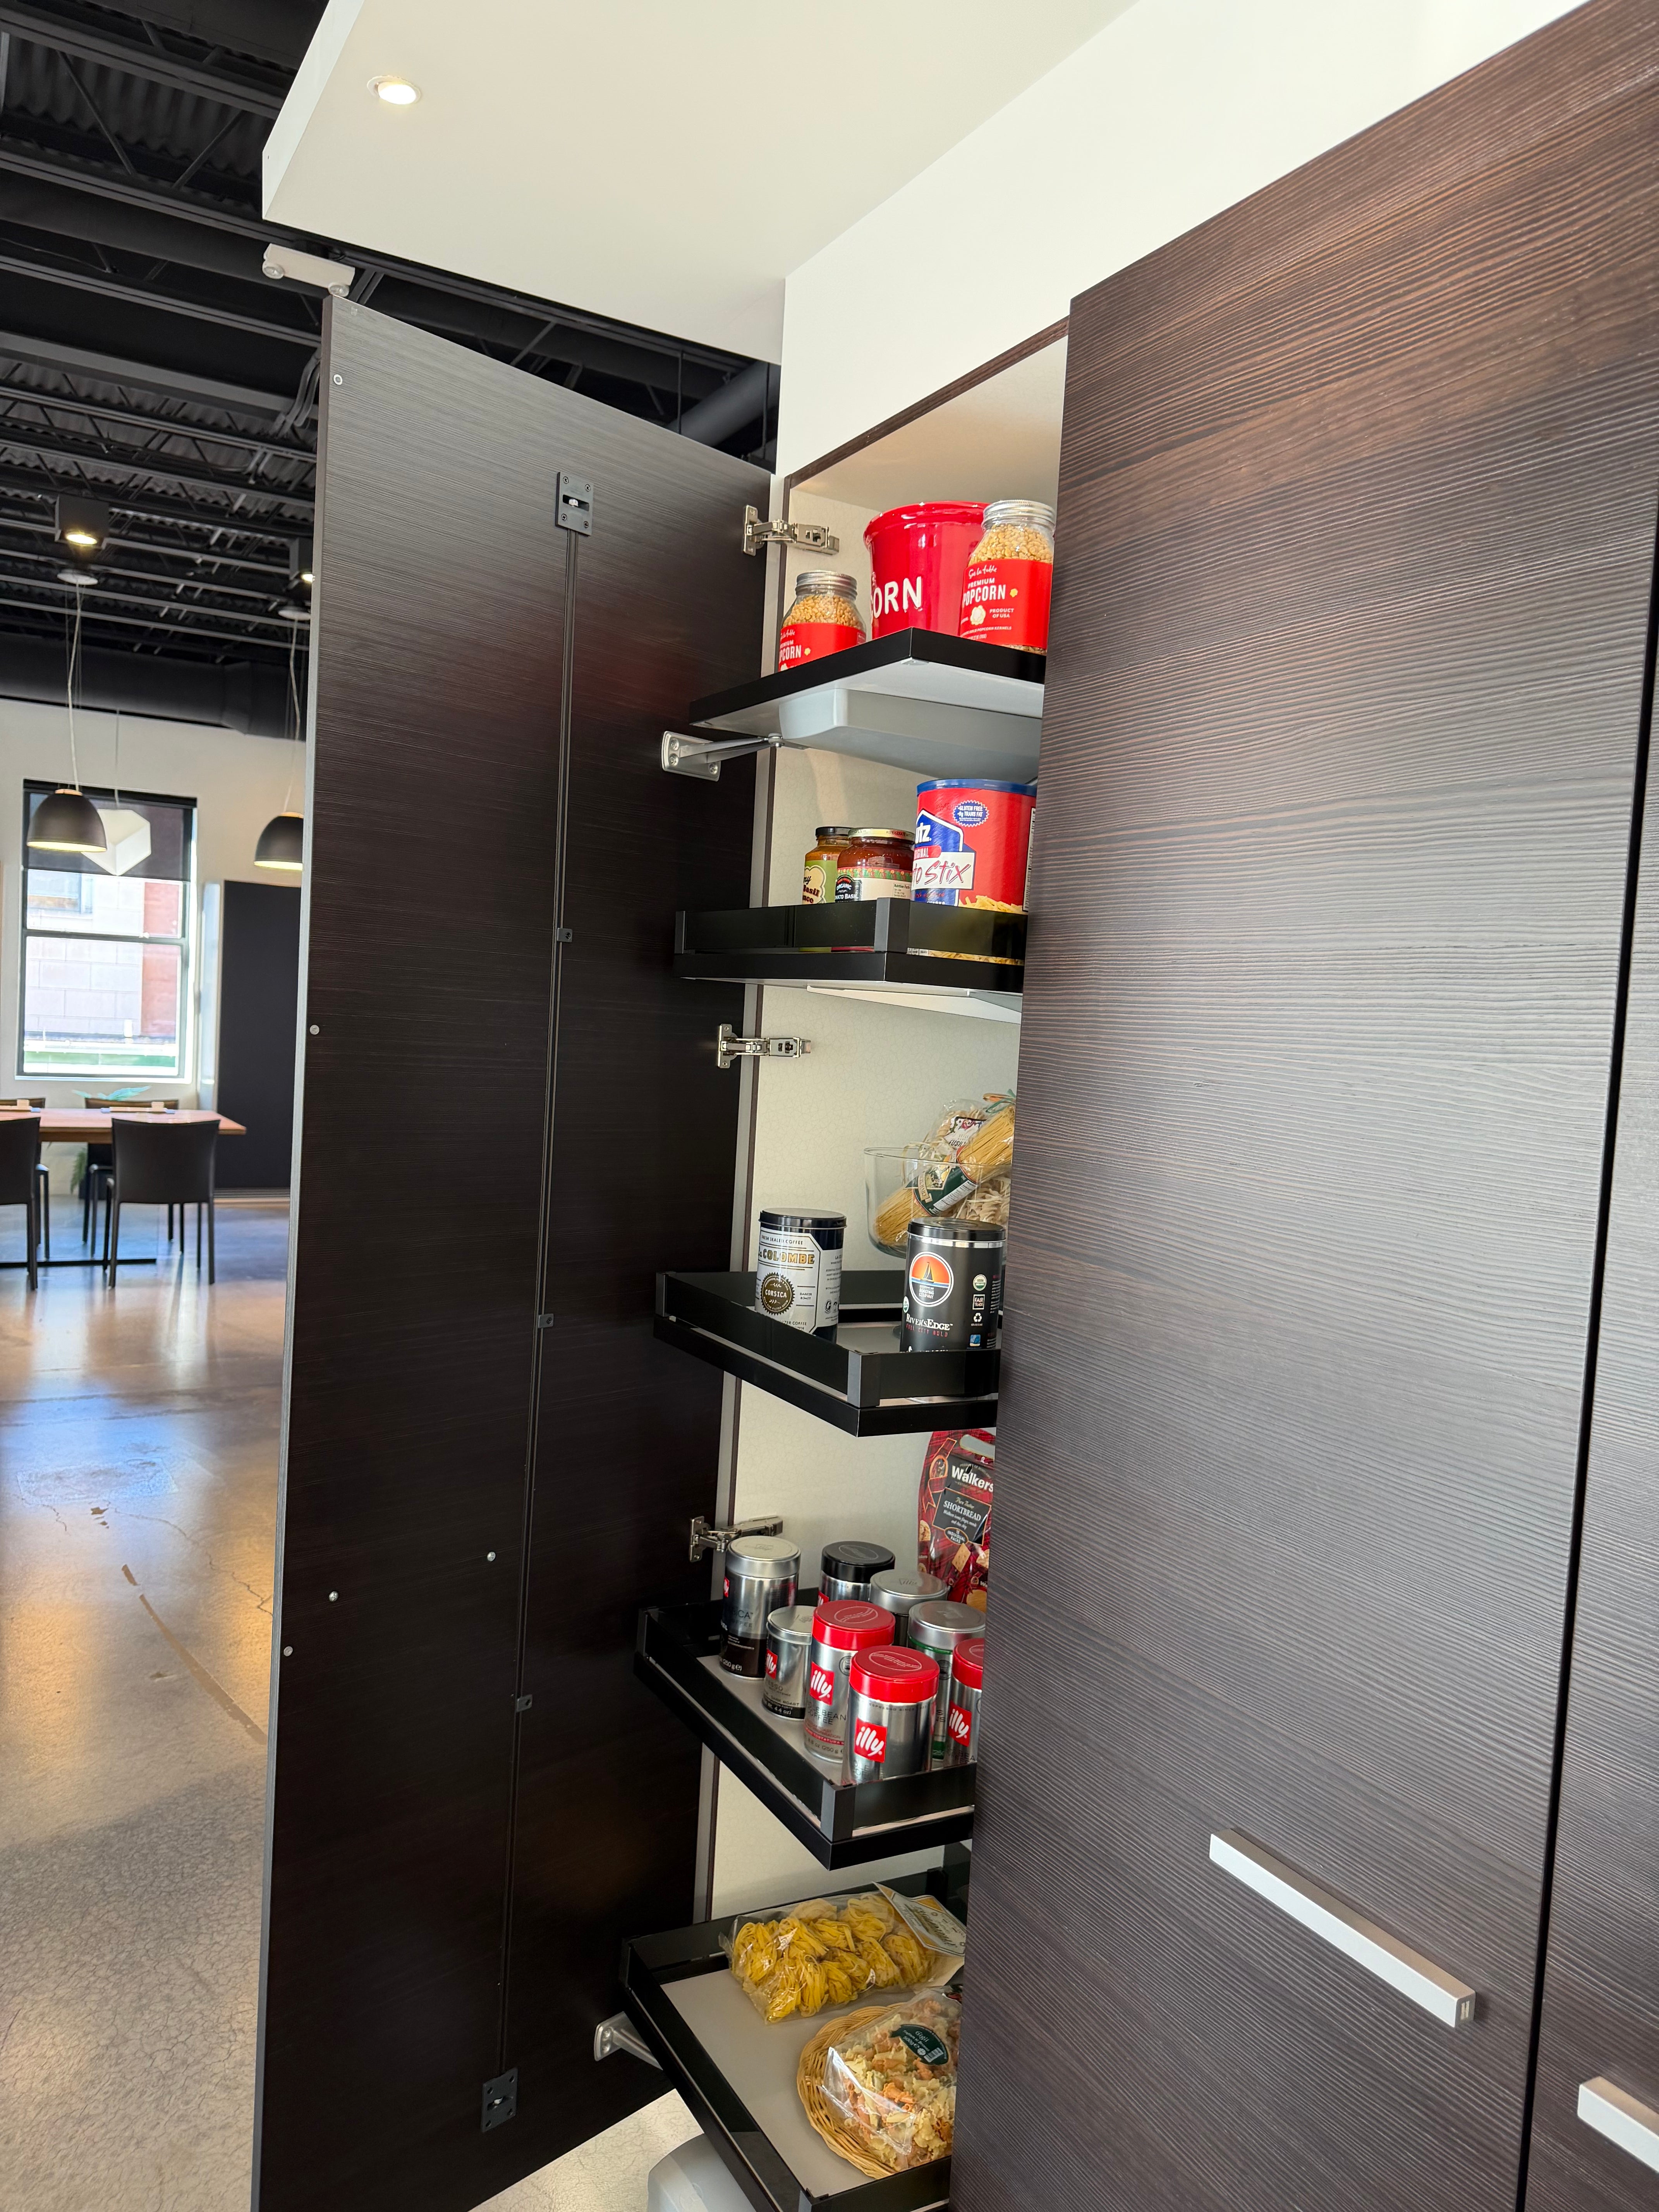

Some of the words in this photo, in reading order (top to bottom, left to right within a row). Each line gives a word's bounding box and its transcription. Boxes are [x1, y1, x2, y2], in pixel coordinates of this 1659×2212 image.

[982, 565, 997, 574] table
[968, 577, 995, 589] PREMIUM
[871, 576, 922, 621] ORN
[963, 584, 1006, 607] POPCORN
[924, 860, 971, 885] Stix
[763, 1249, 815, 1264] COLOMBE
[765, 1289, 787, 1298] CORSICA
[952, 1465, 994, 1492] Walkers
[943, 1500, 981, 1521] SHORTBREAD
[811, 1669, 832, 1698] illy
[822, 1709, 847, 1721] BEAN
[949, 1708, 969, 1738] illy
[856, 1726, 884, 1757] illy
